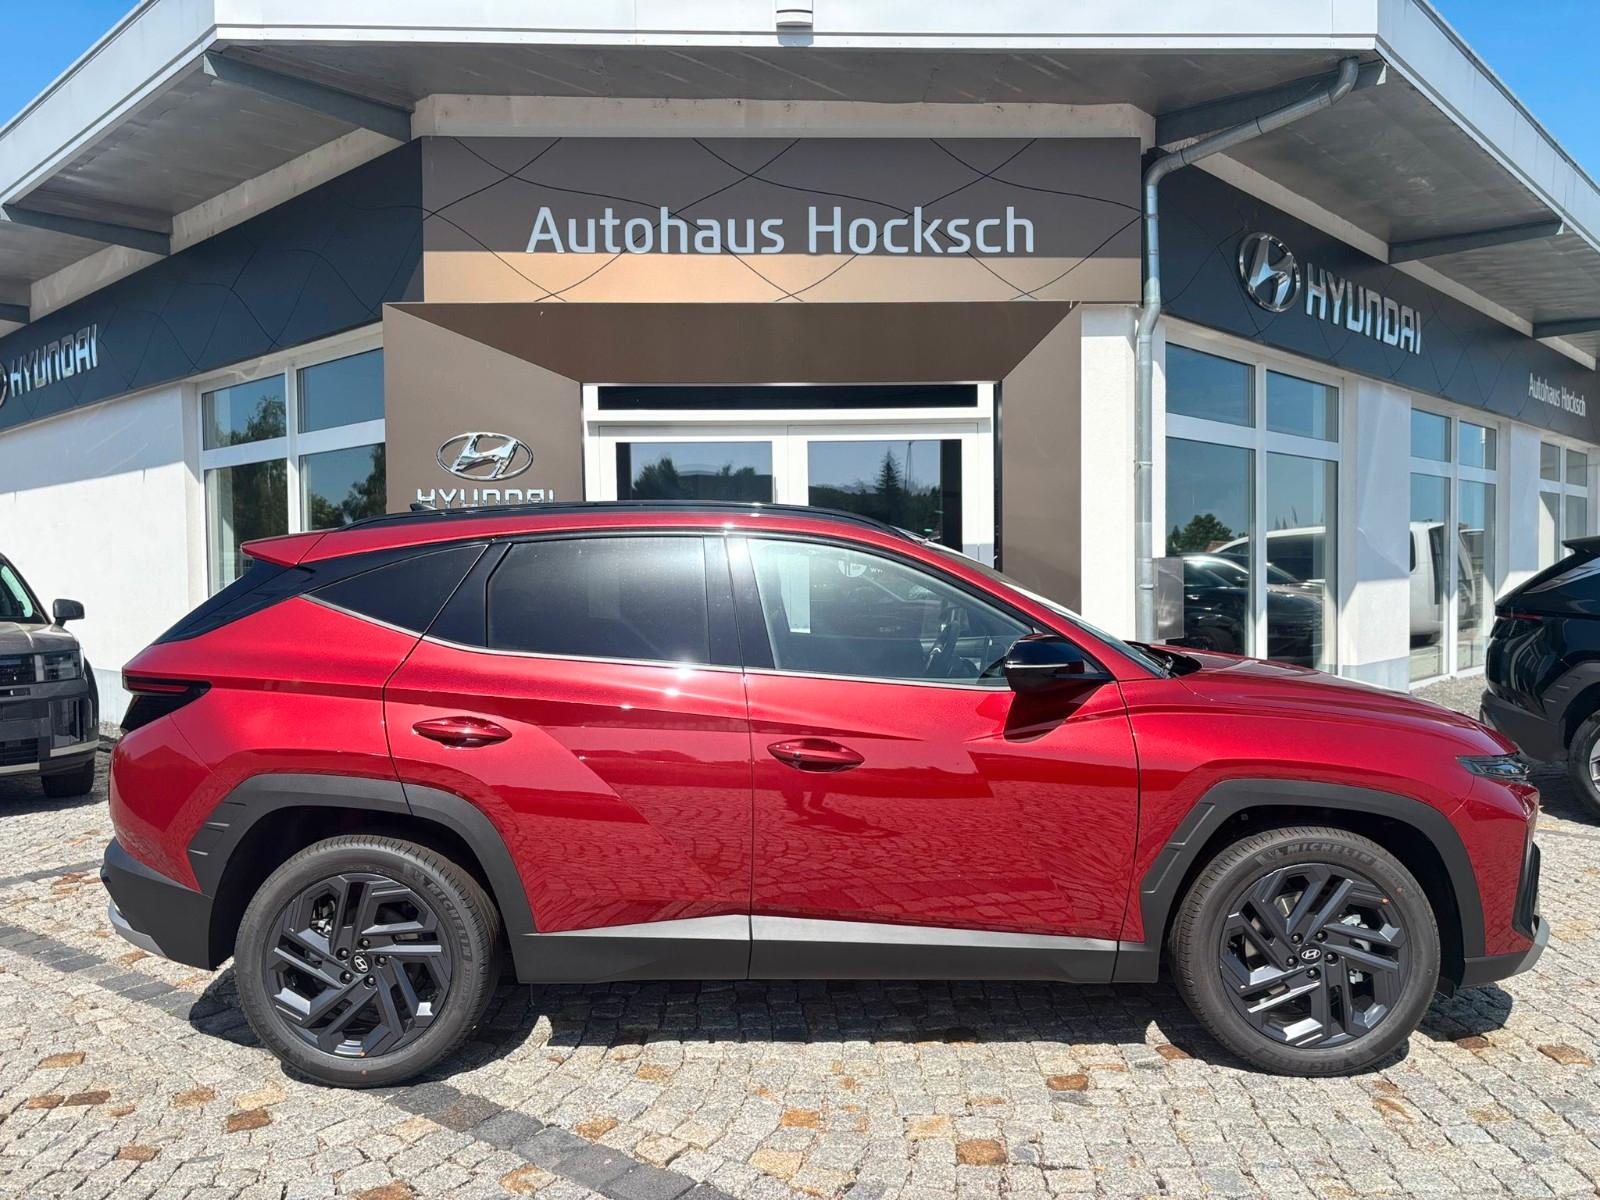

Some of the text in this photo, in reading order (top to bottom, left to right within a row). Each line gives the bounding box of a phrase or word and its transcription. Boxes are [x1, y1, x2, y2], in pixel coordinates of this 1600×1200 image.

[525, 206, 1035, 254] Autohaus Hocksch
[1305, 262, 1422, 355] HYUNDAI
[10, 323, 98, 398] HYUNDAI
[1528, 372, 1586, 417] Autohaus Hocksch
[416, 488, 554, 508] HYUNDAI
[1286, 842, 1375, 865] MICHELIN
